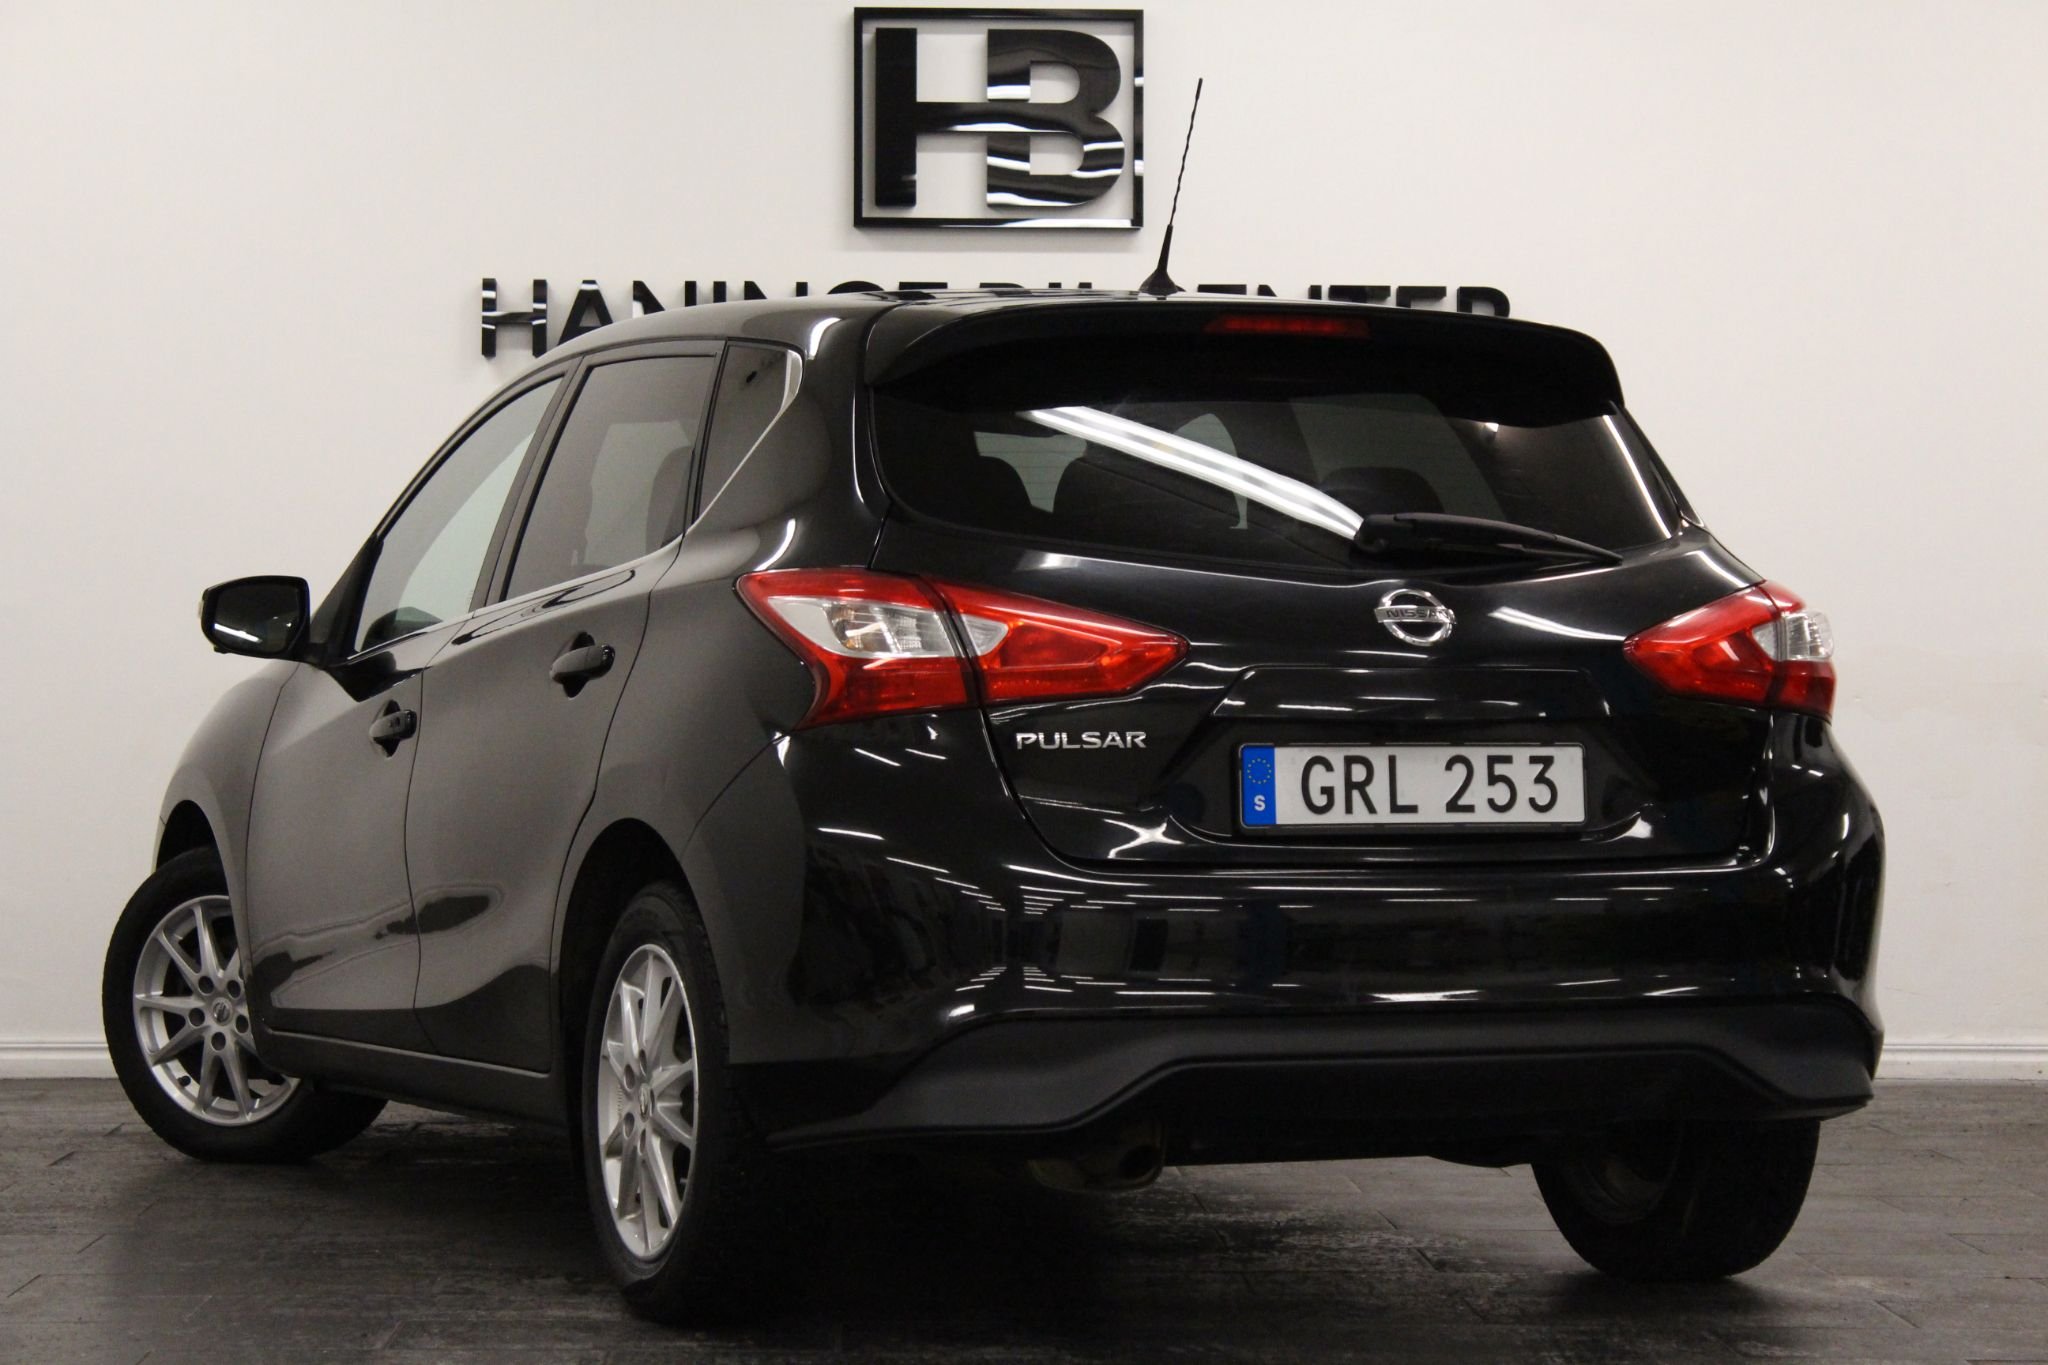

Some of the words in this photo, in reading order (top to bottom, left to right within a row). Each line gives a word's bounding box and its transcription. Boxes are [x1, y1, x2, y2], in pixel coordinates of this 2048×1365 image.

[875, 28, 1125, 208] HB
[1015, 731, 1147, 750] PULSAR
[1254, 794, 1266, 811] S
[1301, 754, 1419, 815] GRL
[1444, 754, 1558, 814] 253
